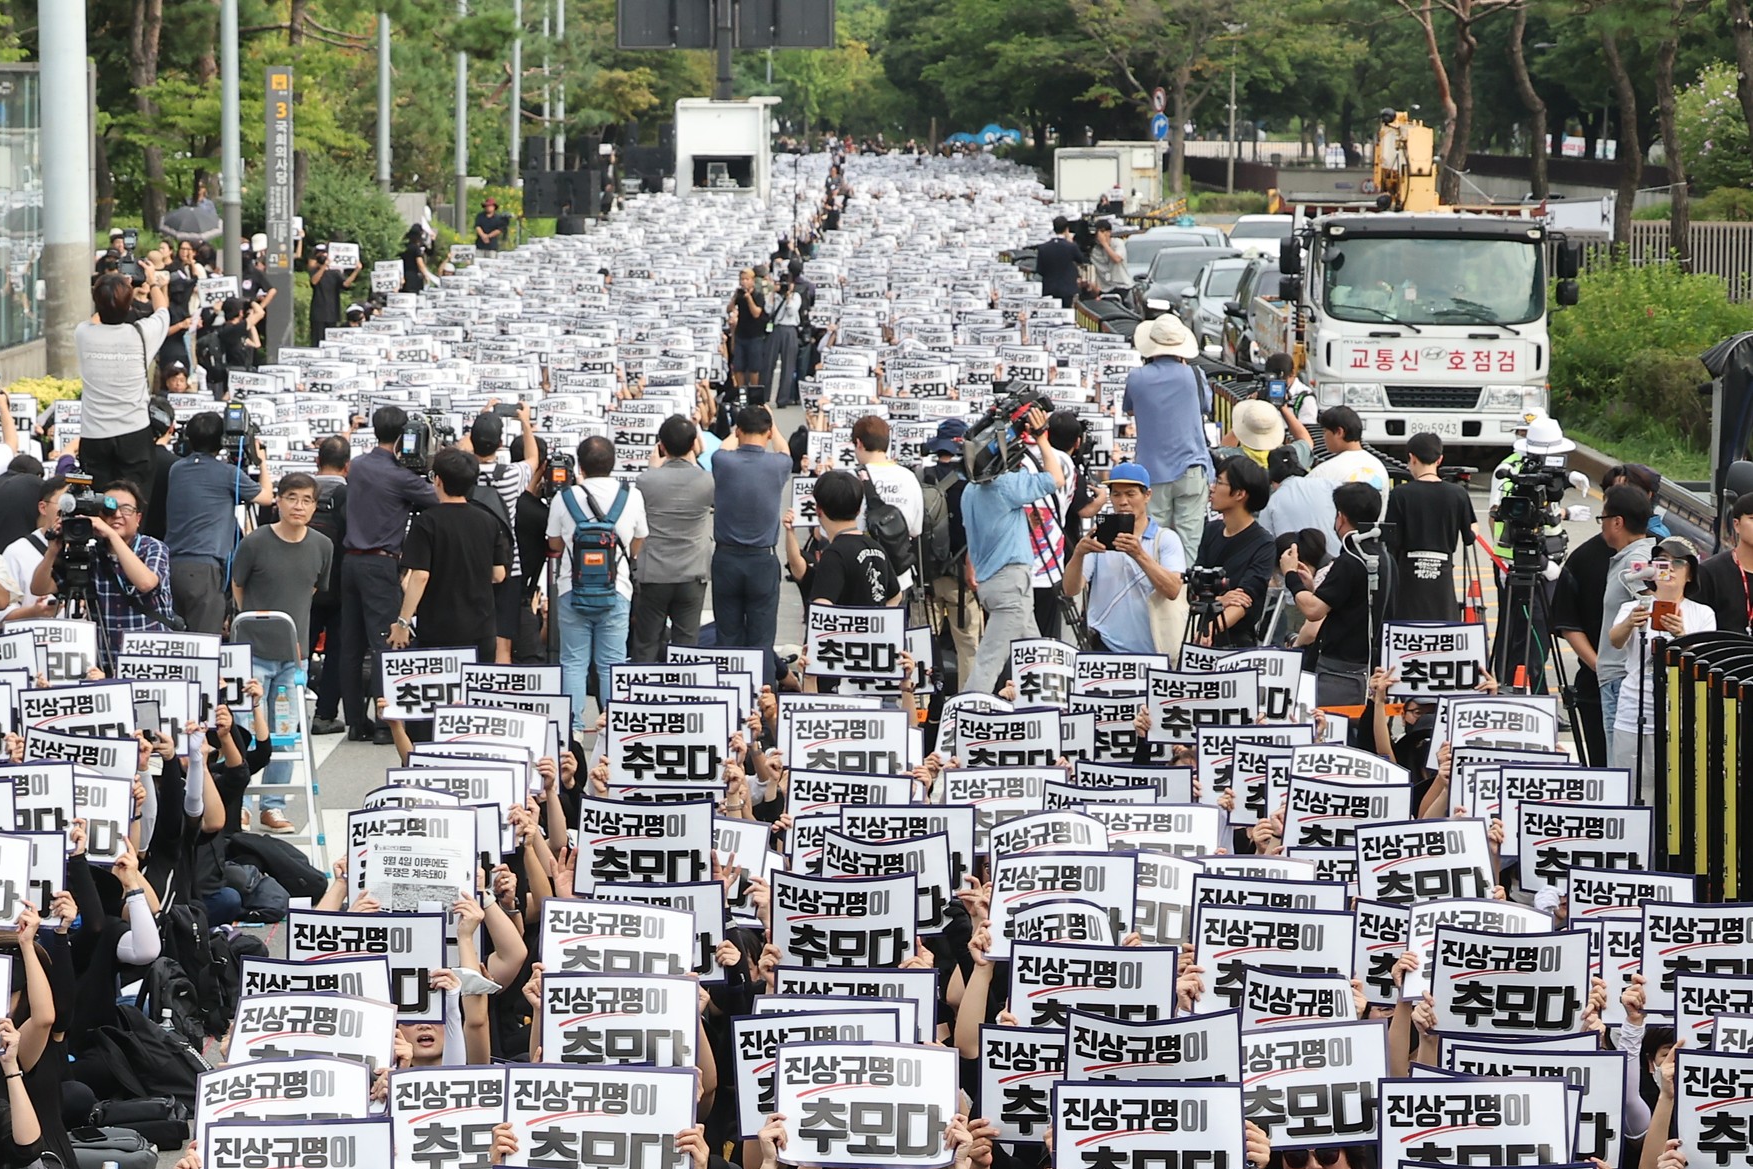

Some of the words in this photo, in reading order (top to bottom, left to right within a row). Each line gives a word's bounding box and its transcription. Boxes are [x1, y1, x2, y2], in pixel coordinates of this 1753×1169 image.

[276, 103, 287, 118] 3
[275, 121, 288, 185] 국회의사당
[811, 611, 884, 635] 진상규명이
[817, 639, 900, 673] 추모다
[1392, 632, 1468, 651] 진상규명이
[1401, 659, 1480, 691] 추모다
[612, 711, 704, 735] 진상규명이
[622, 745, 724, 782] 추모다
[584, 811, 686, 839] 진상규명이
[1524, 812, 1625, 839] 진상규명이
[383, 856, 396, 865] 9월
[398, 857, 412, 866] 4일
[415, 858, 449, 868] 이후에도
[384, 868, 409, 878] 투쟁은
[591, 848, 708, 884] 추모다
[294, 923, 412, 953] 진상규명이
[787, 925, 911, 967] 추모다
[1017, 955, 1142, 987] 진상규명이
[1451, 981, 1579, 1029] 추모다
[241, 1007, 363, 1037] 진상규명이
[1073, 1026, 1208, 1065] 진상규명이
[204, 1068, 335, 1106] 진상규명이
[784, 1056, 922, 1086] 진상규명이
[514, 1080, 657, 1115] 진상규명이
[1387, 1094, 1530, 1126] 진상규명이
[798, 1098, 947, 1156] 추모다
[1063, 1097, 1208, 1133] 진상규명이
[215, 1136, 356, 1168] 진상규명이
